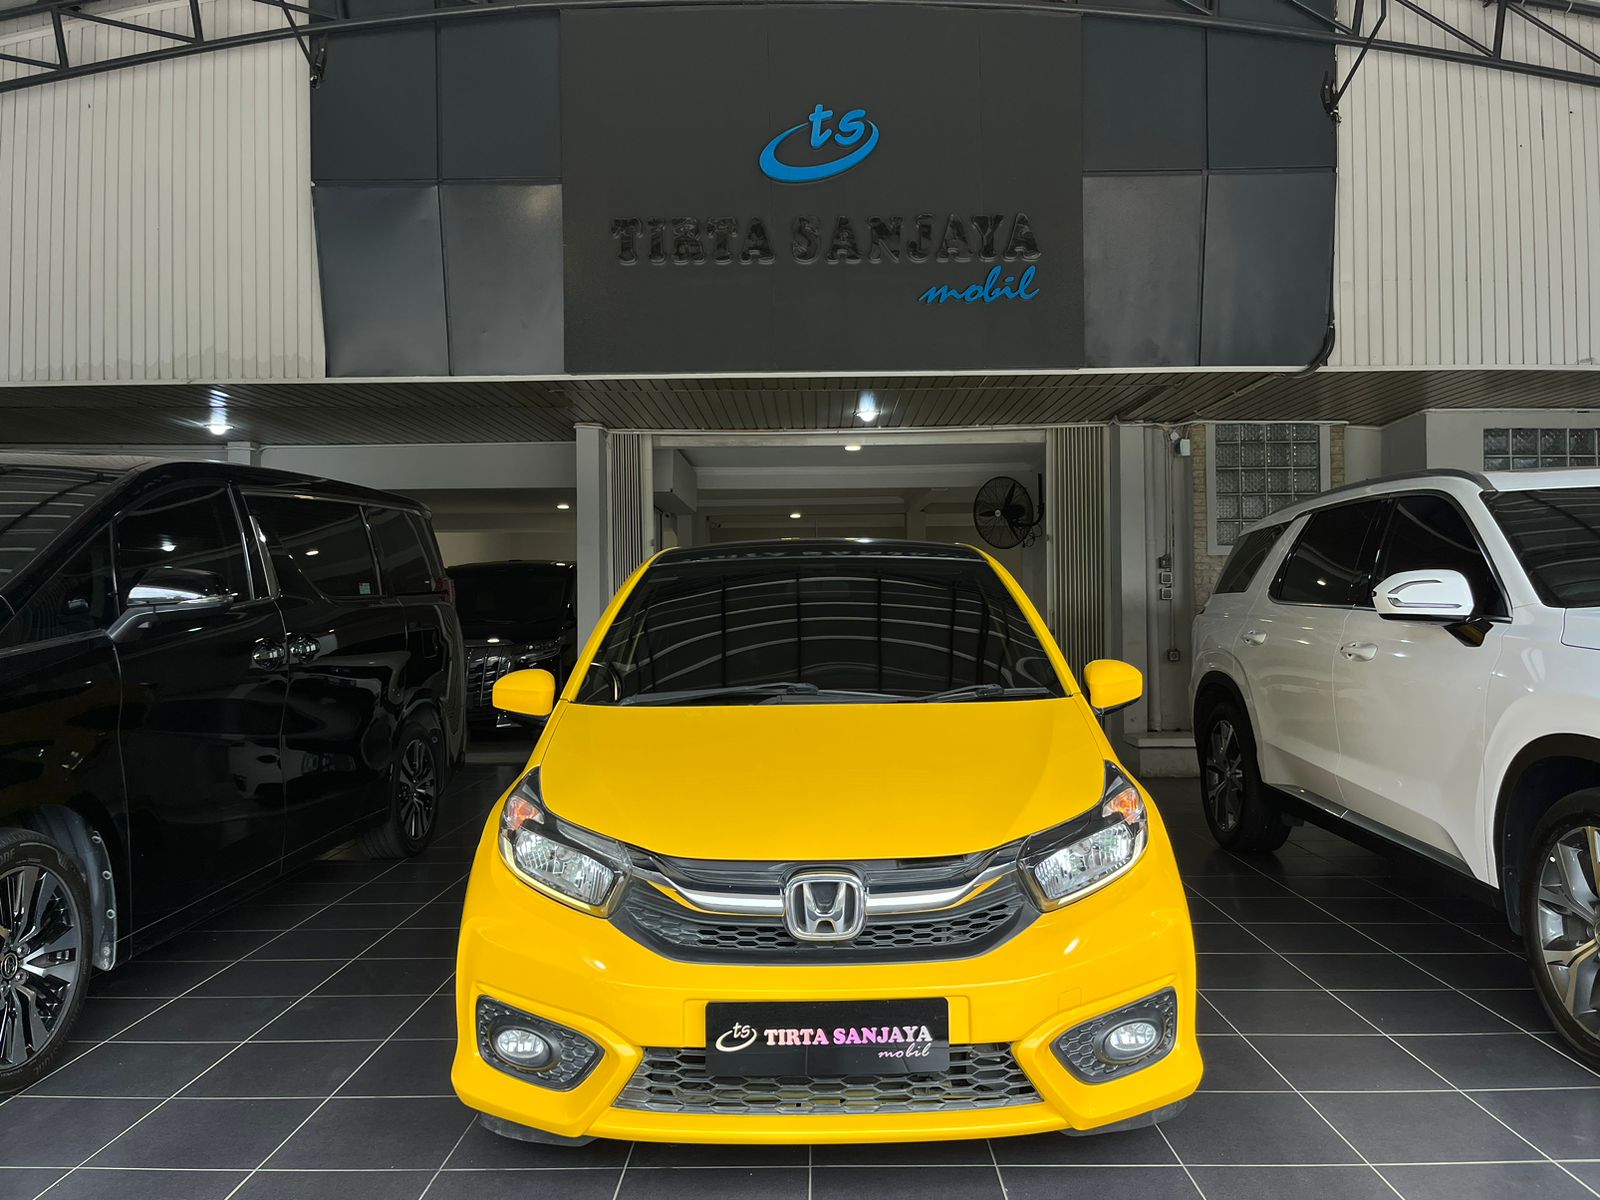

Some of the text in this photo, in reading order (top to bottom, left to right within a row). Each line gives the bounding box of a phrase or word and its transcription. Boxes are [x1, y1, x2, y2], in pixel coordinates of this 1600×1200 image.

[808, 103, 867, 149] ts
[611, 211, 1042, 266] TIRTA SANJAYA
[919, 265, 1041, 303] mobil
[732, 1022, 751, 1039] ts
[763, 1025, 933, 1047] TIRTA SANJAYA
[878, 1043, 931, 1060] mobil
